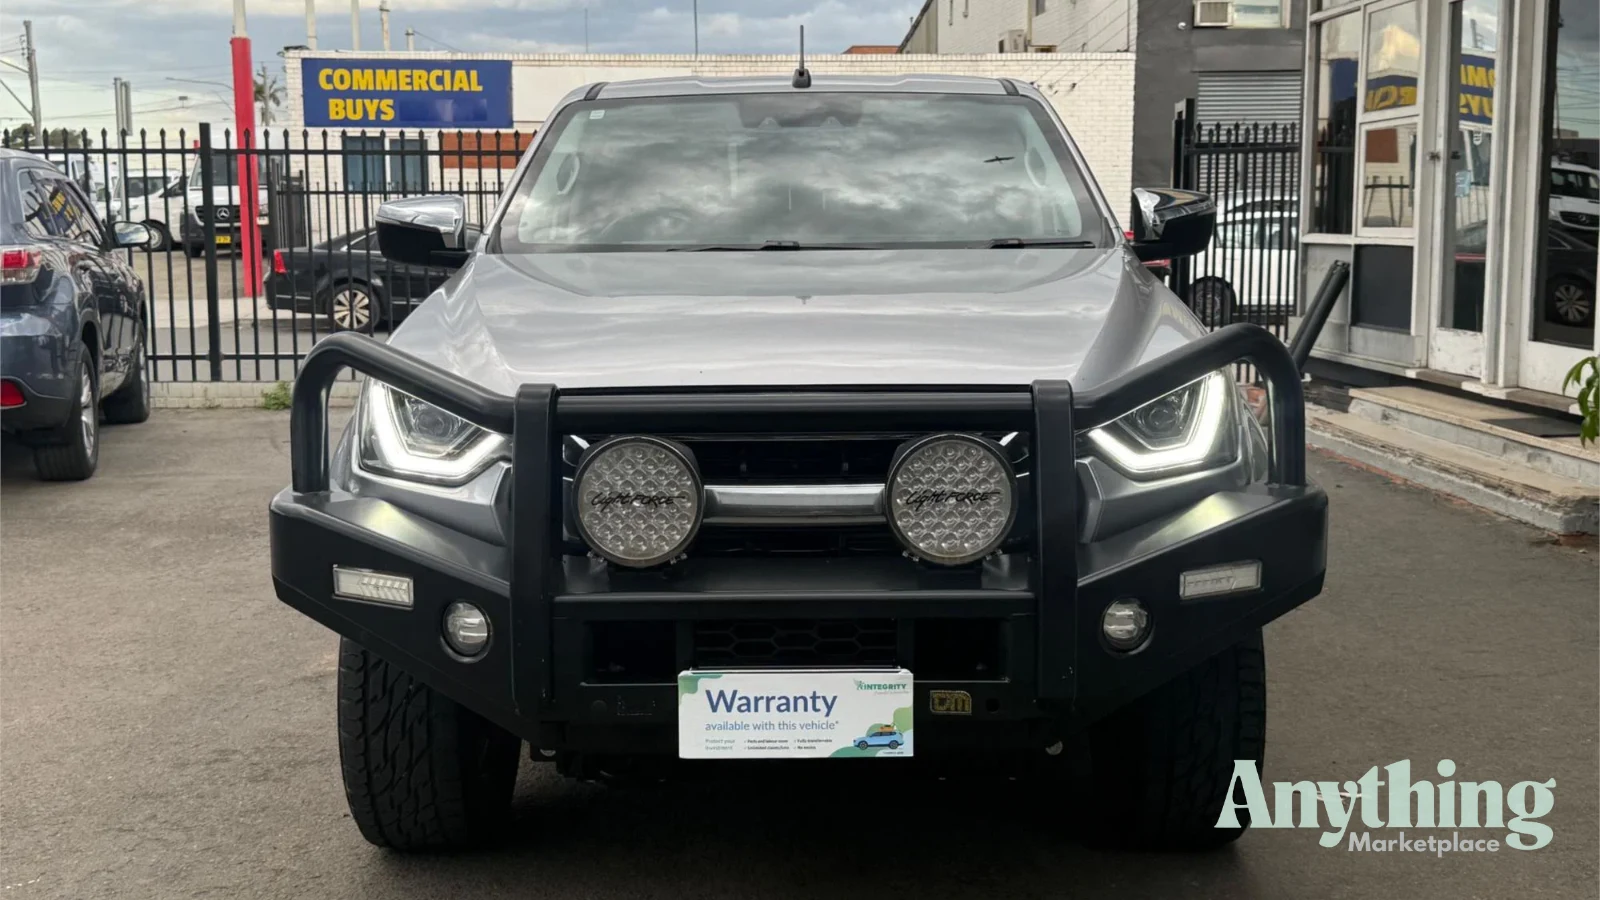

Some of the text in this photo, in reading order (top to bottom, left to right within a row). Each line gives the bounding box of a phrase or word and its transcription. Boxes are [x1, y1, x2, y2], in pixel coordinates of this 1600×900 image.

[318, 68, 483, 92] COMMERCIAL
[328, 98, 395, 121] BUYS
[705, 689, 838, 717] Warranty
[705, 721, 750, 731] available
[752, 720, 775, 731] with
[778, 720, 797, 731] this
